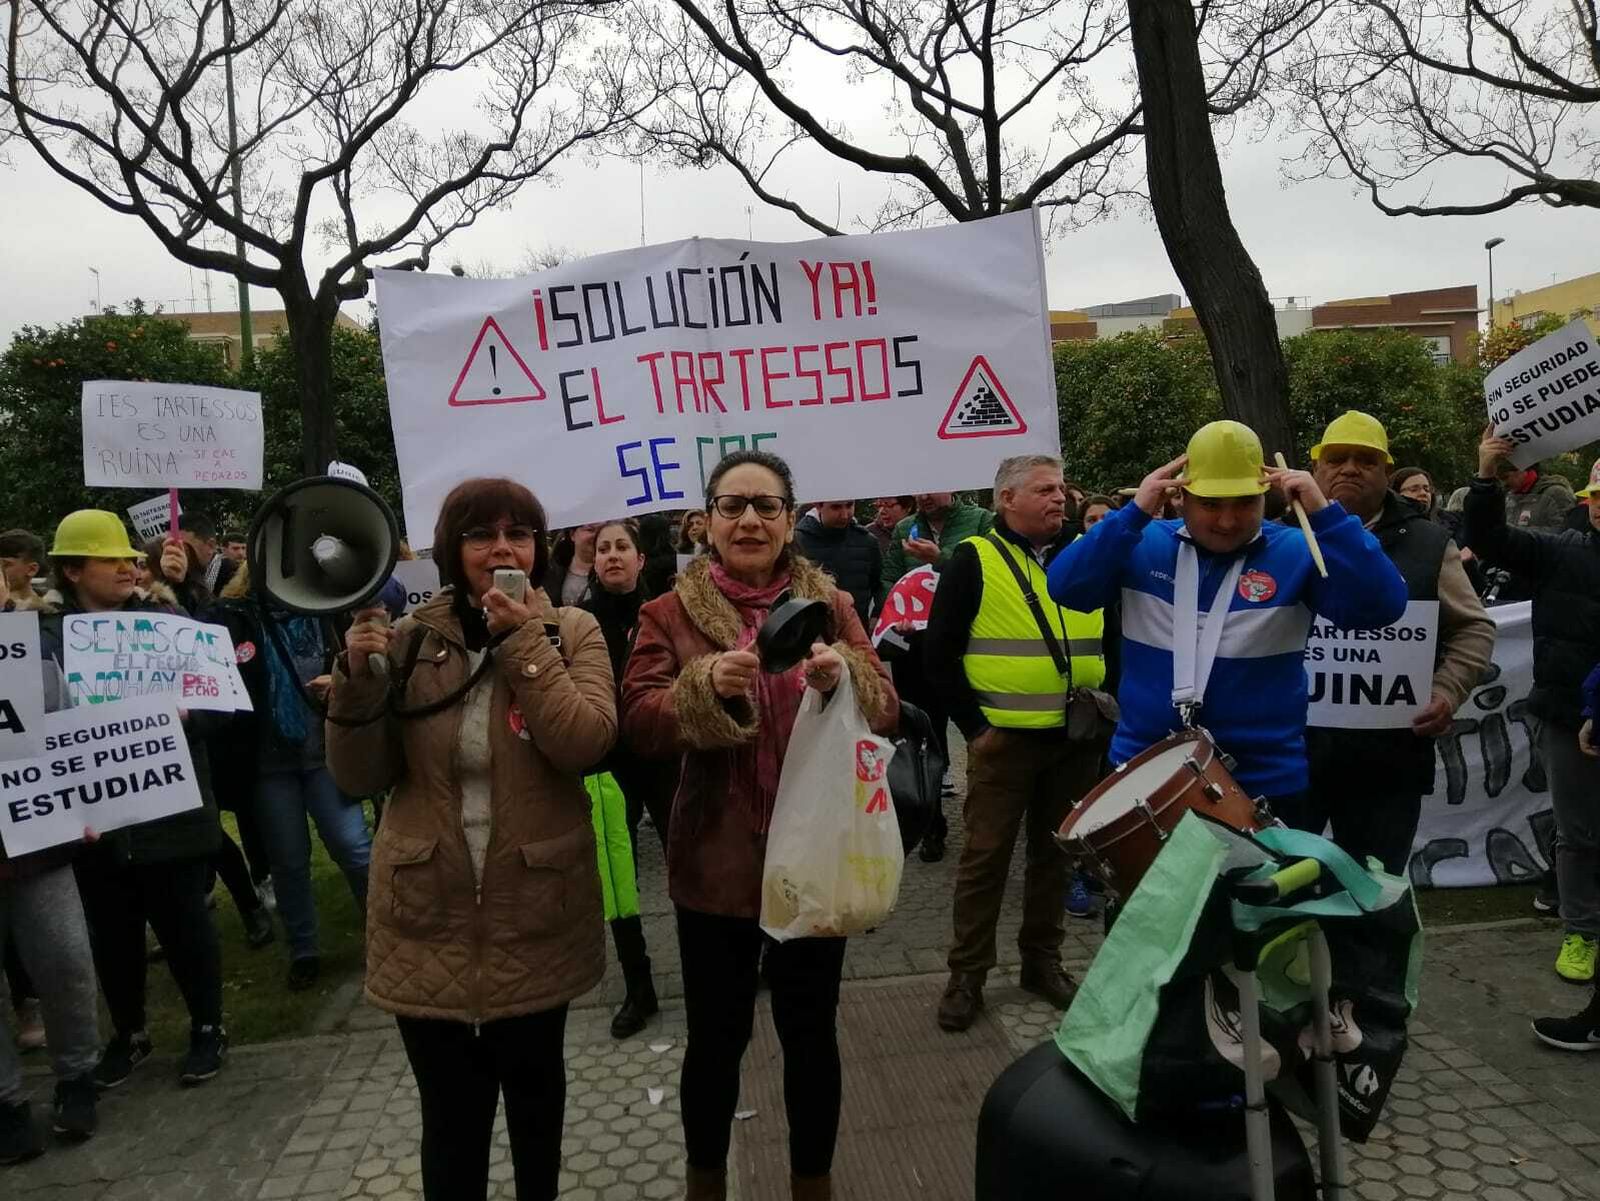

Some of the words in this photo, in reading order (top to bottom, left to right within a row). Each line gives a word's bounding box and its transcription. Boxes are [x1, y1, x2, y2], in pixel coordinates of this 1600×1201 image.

[799, 259, 877, 321] YA!
[558, 366, 625, 431] EL
[636, 335, 924, 414] TARTESSOS
[1488, 386, 1503, 406] SIN
[1504, 340, 1589, 394] SEGURIDAD
[97, 394, 138, 418] IES
[1491, 407, 1510, 425] NO
[1512, 394, 1537, 414] SE
[1537, 361, 1600, 402] PUEDE
[137, 422, 166, 441] ES
[178, 424, 217, 442] UNA
[1500, 388, 1600, 447] STUDIA
[194, 469, 249, 482] PEDAZOS
[616, 437, 685, 506] SE
[1308, 625, 1428, 642] ARTESSOS
[1304, 647, 1325, 661] ES
[1333, 648, 1382, 663] UNA
[182, 673, 219, 687] DER
[182, 686, 220, 698] ECHO
[1308, 672, 1418, 706] UINA
[45, 713, 171, 751] SEGURIDAD
[1, 766, 42, 789] NO
[50, 756, 86, 777] SE
[94, 735, 177, 768] PUEDE
[8, 762, 186, 823] ESTUDIAR
